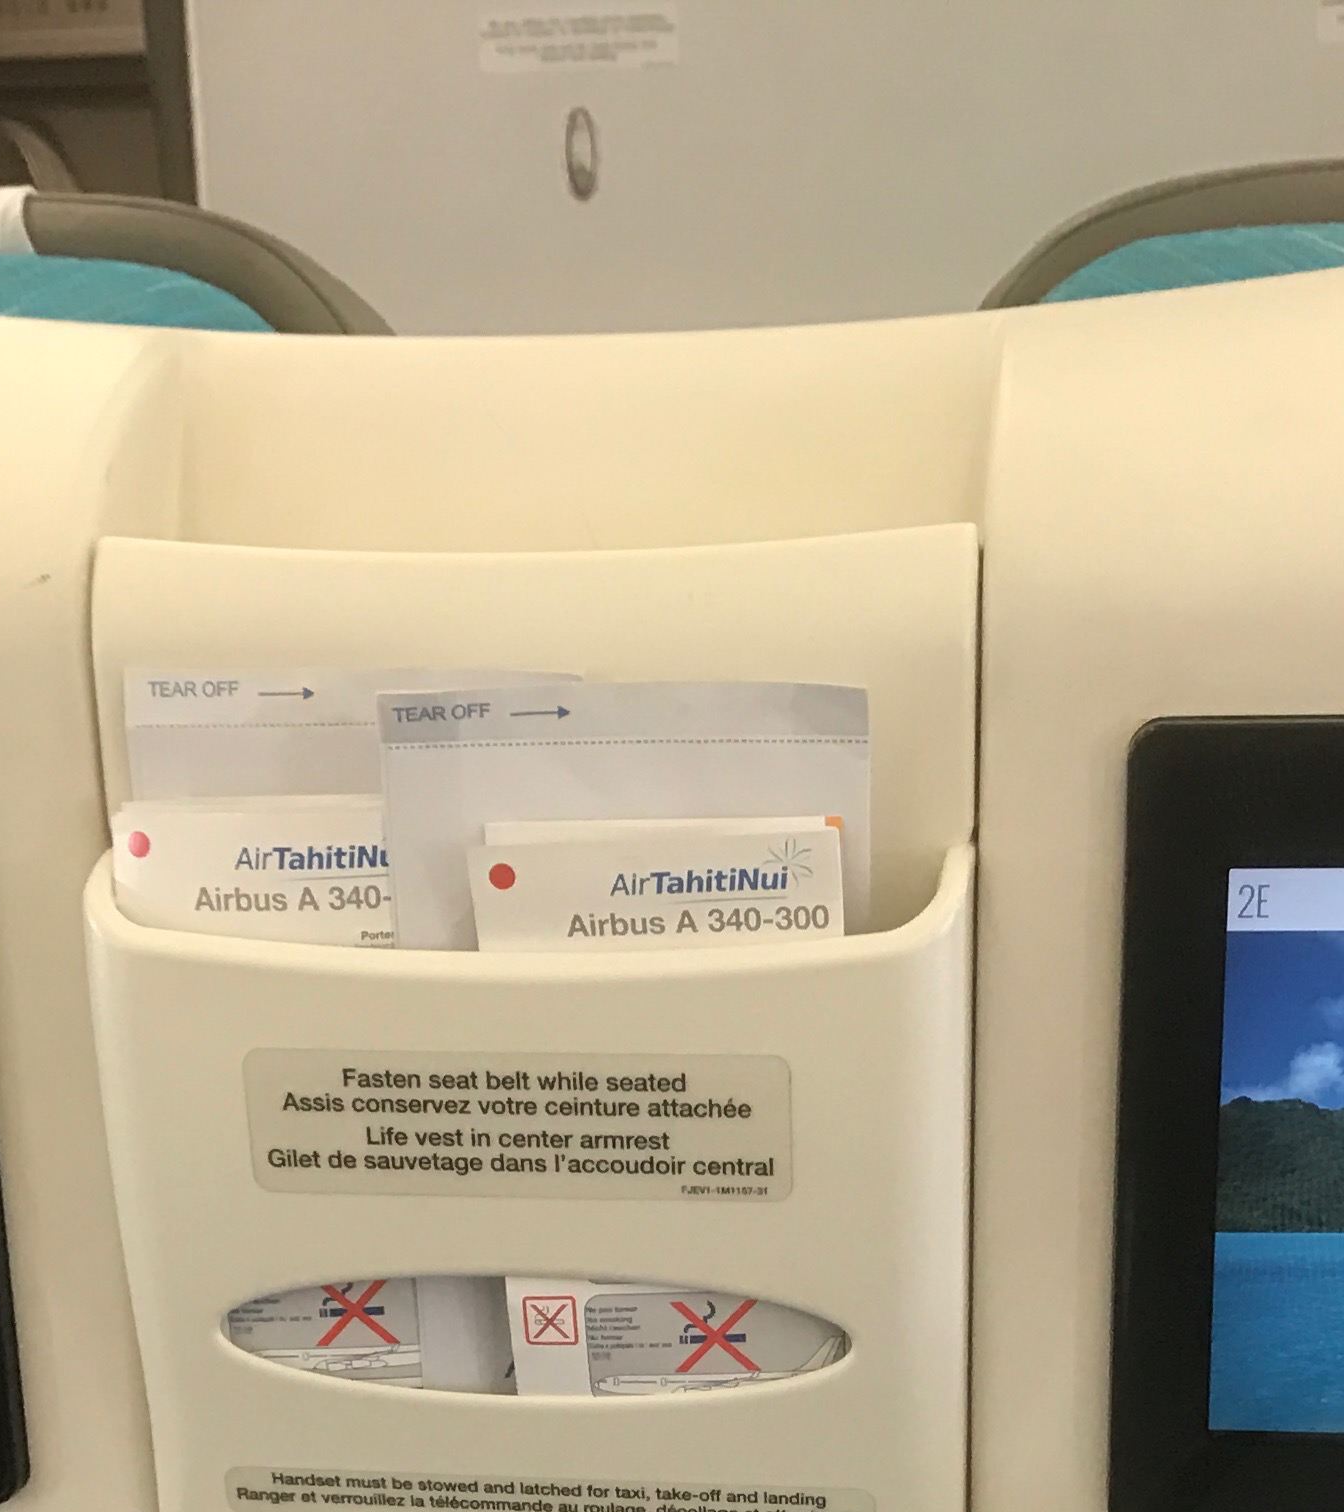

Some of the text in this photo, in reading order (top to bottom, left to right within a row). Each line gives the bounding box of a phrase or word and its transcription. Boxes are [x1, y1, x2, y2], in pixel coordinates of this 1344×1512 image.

[148, 681, 239, 697] TEAR OFF
[391, 703, 490, 722] TEAR OFF
[235, 845, 388, 872] AirTahitiN
[610, 865, 789, 898] AirTahitiNui
[195, 885, 391, 911] Airbus A 340-
[1238, 884, 1270, 919] 2E
[568, 905, 829, 937] Airbus A 340-300
[343, 1068, 686, 1092] Fasten seat belt while seated
[283, 1092, 751, 1118] Assis conservez votre ceinture attachée
[367, 1126, 669, 1150] Life vest in center armrest
[268, 1149, 773, 1176] Gilet de sauvetage dans l'accoudoir central
[237, 1487, 295, 1504] Ranger
[301, 1491, 316, 1503] et
[321, 1493, 405, 1506] verrouillez
[410, 1495, 425, 1507] la
[429, 1495, 553, 1512] télécommande
[271, 1472, 341, 1487] Handset
[392, 1478, 412, 1490] be
[418, 1479, 478, 1493] stowed
[484, 1482, 514, 1494] and
[520, 1482, 582, 1497] latched
[587, 1485, 610, 1498] for
[615, 1487, 650, 1501] taxi,
[655, 1488, 721, 1502] take-off
[727, 1491, 758, 1503] and
[764, 1492, 826, 1509] landing
